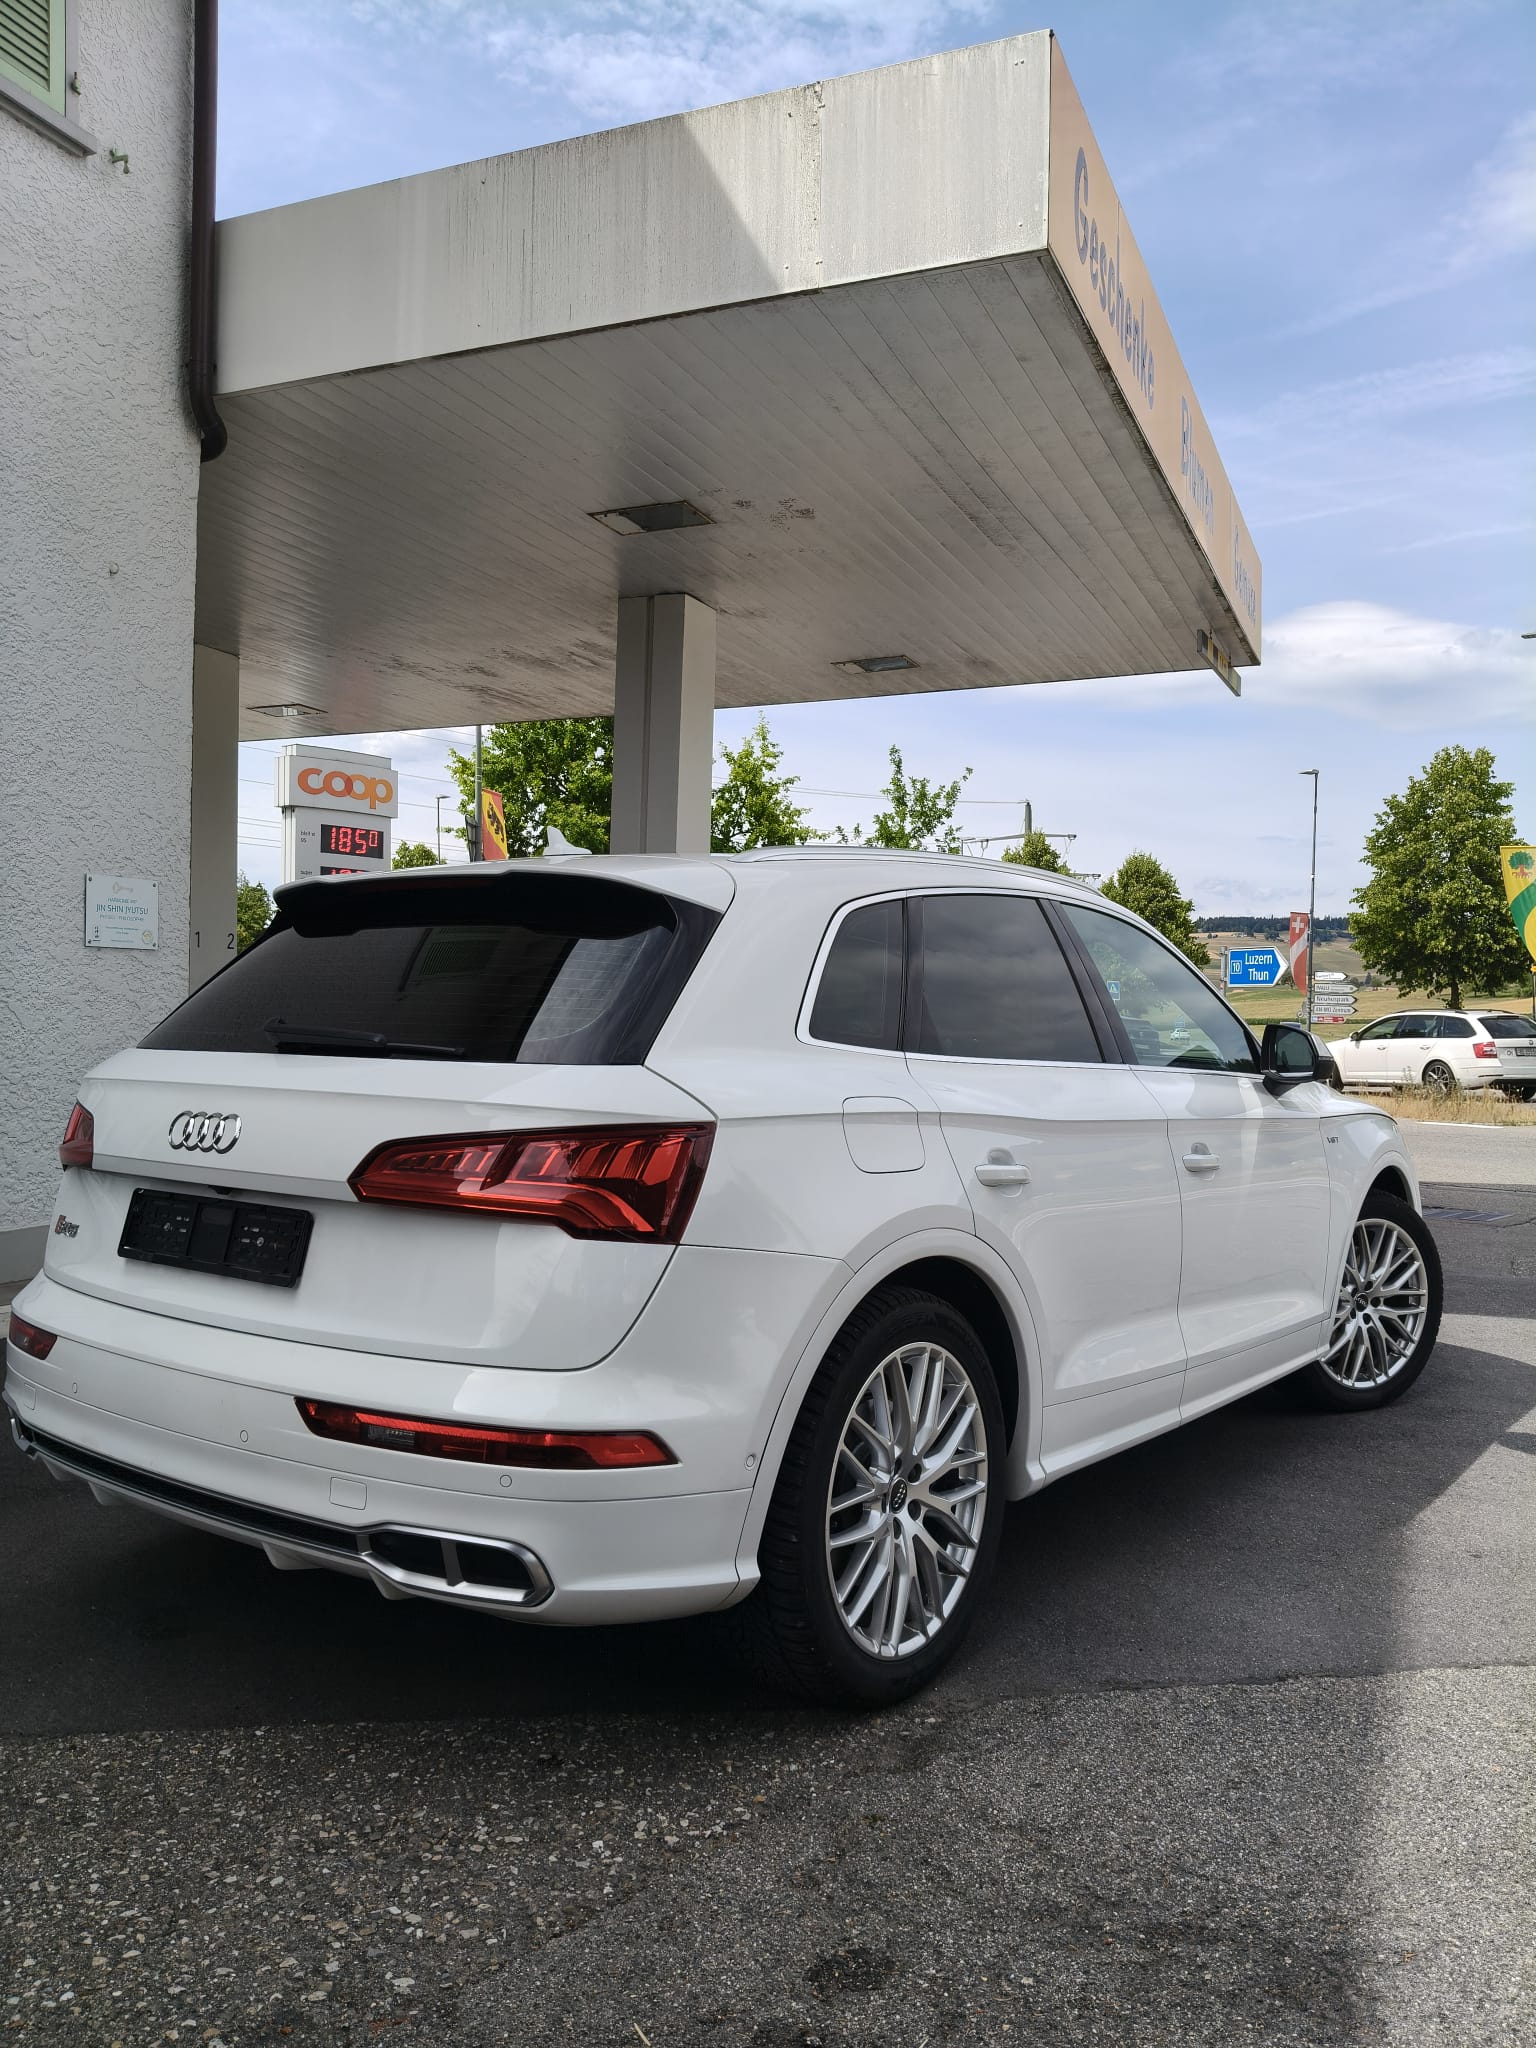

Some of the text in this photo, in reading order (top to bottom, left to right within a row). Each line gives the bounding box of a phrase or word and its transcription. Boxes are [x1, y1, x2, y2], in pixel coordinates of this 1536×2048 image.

[1074, 146, 1155, 410] Geschenke
[1181, 395, 1214, 536] Blumen
[297, 767, 393, 810] coop
[96, 904, 149, 915] JIN SHIN JYUTSU
[194, 931, 201, 948] 1
[227, 933, 235, 949] 2
[1245, 952, 1273, 965] Luzern
[1232, 962, 1241, 973] 10
[1248, 968, 1269, 981] Thun
